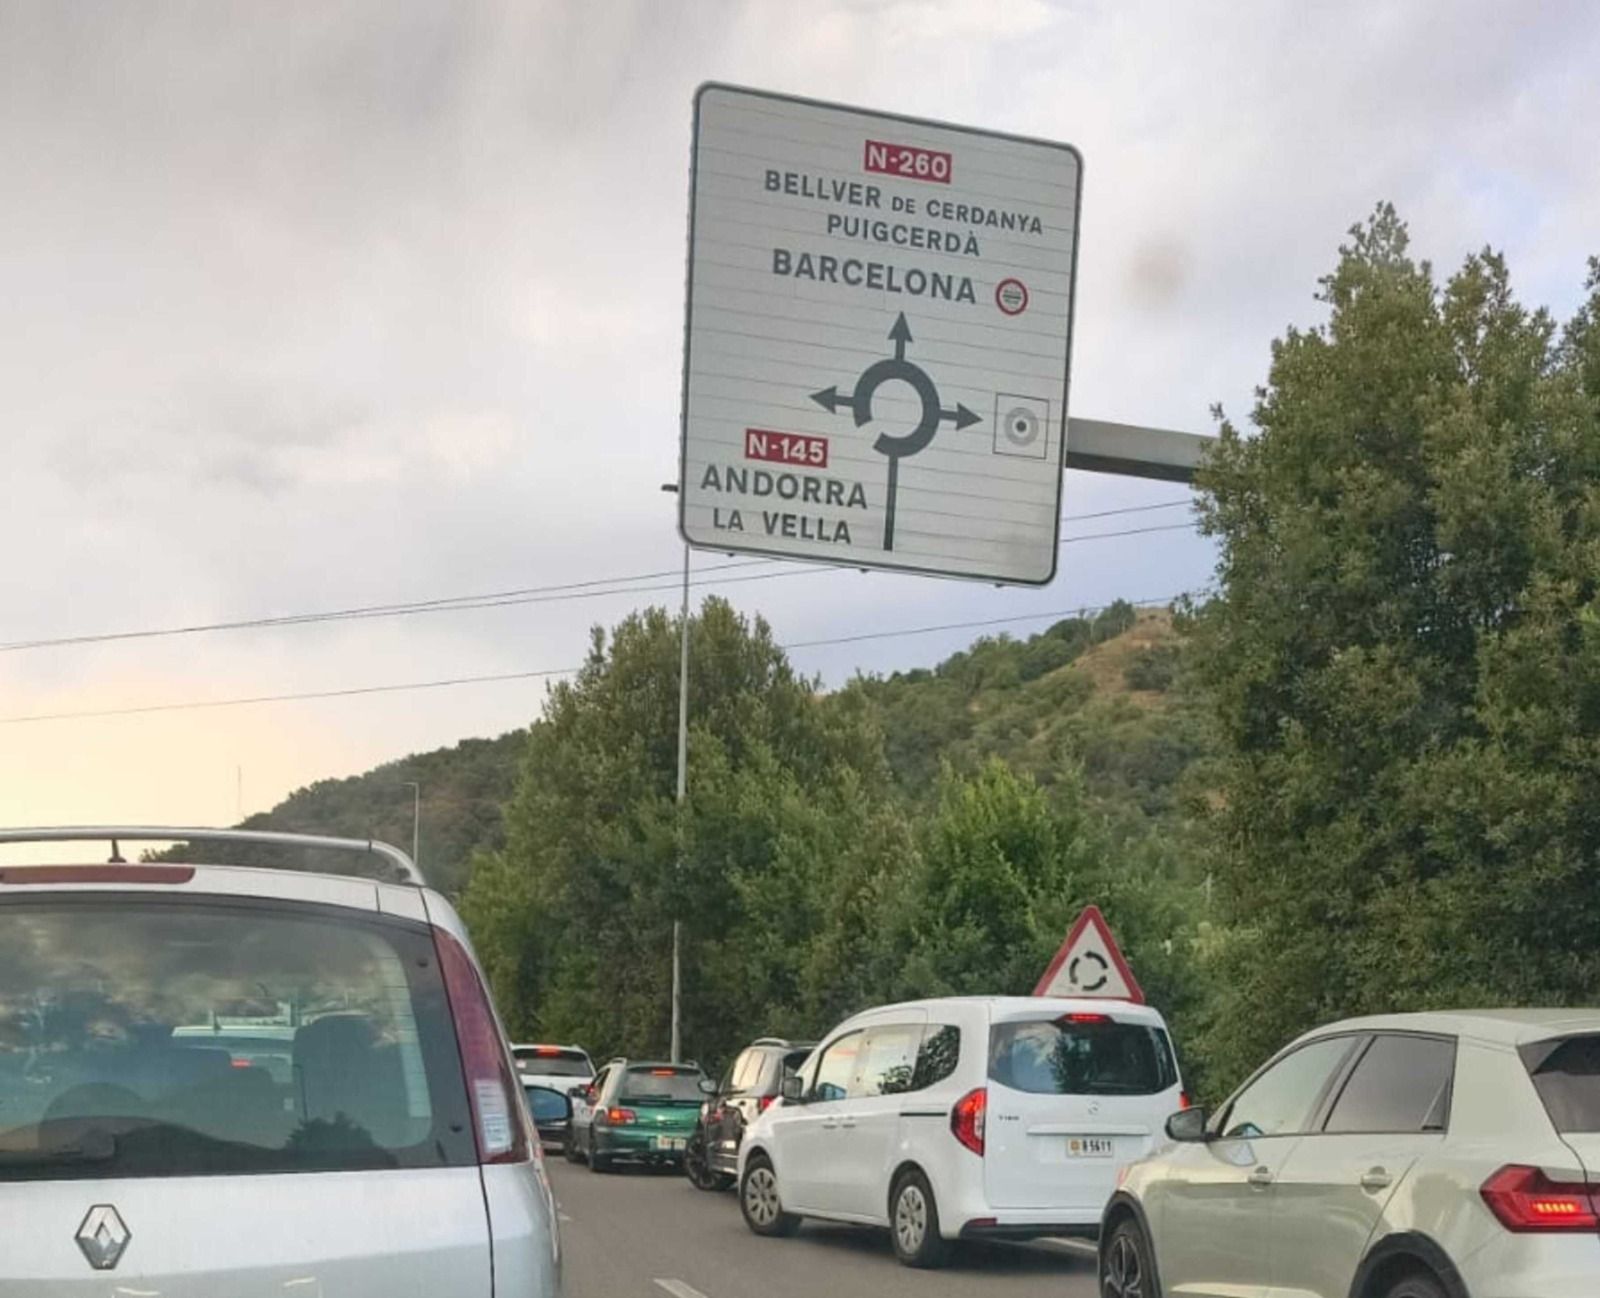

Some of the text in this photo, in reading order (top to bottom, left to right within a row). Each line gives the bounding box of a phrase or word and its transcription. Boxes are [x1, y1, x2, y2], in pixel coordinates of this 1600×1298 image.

[867, 147, 948, 179] N-260
[765, 169, 1042, 234] BELLVER DE CERDANYA
[827, 214, 980, 256] PUIGCERDÀ
[772, 248, 976, 304] BARCELONA
[748, 434, 824, 462] N-145
[701, 463, 867, 509] ANDORRA
[713, 508, 852, 544] LA VELLA
